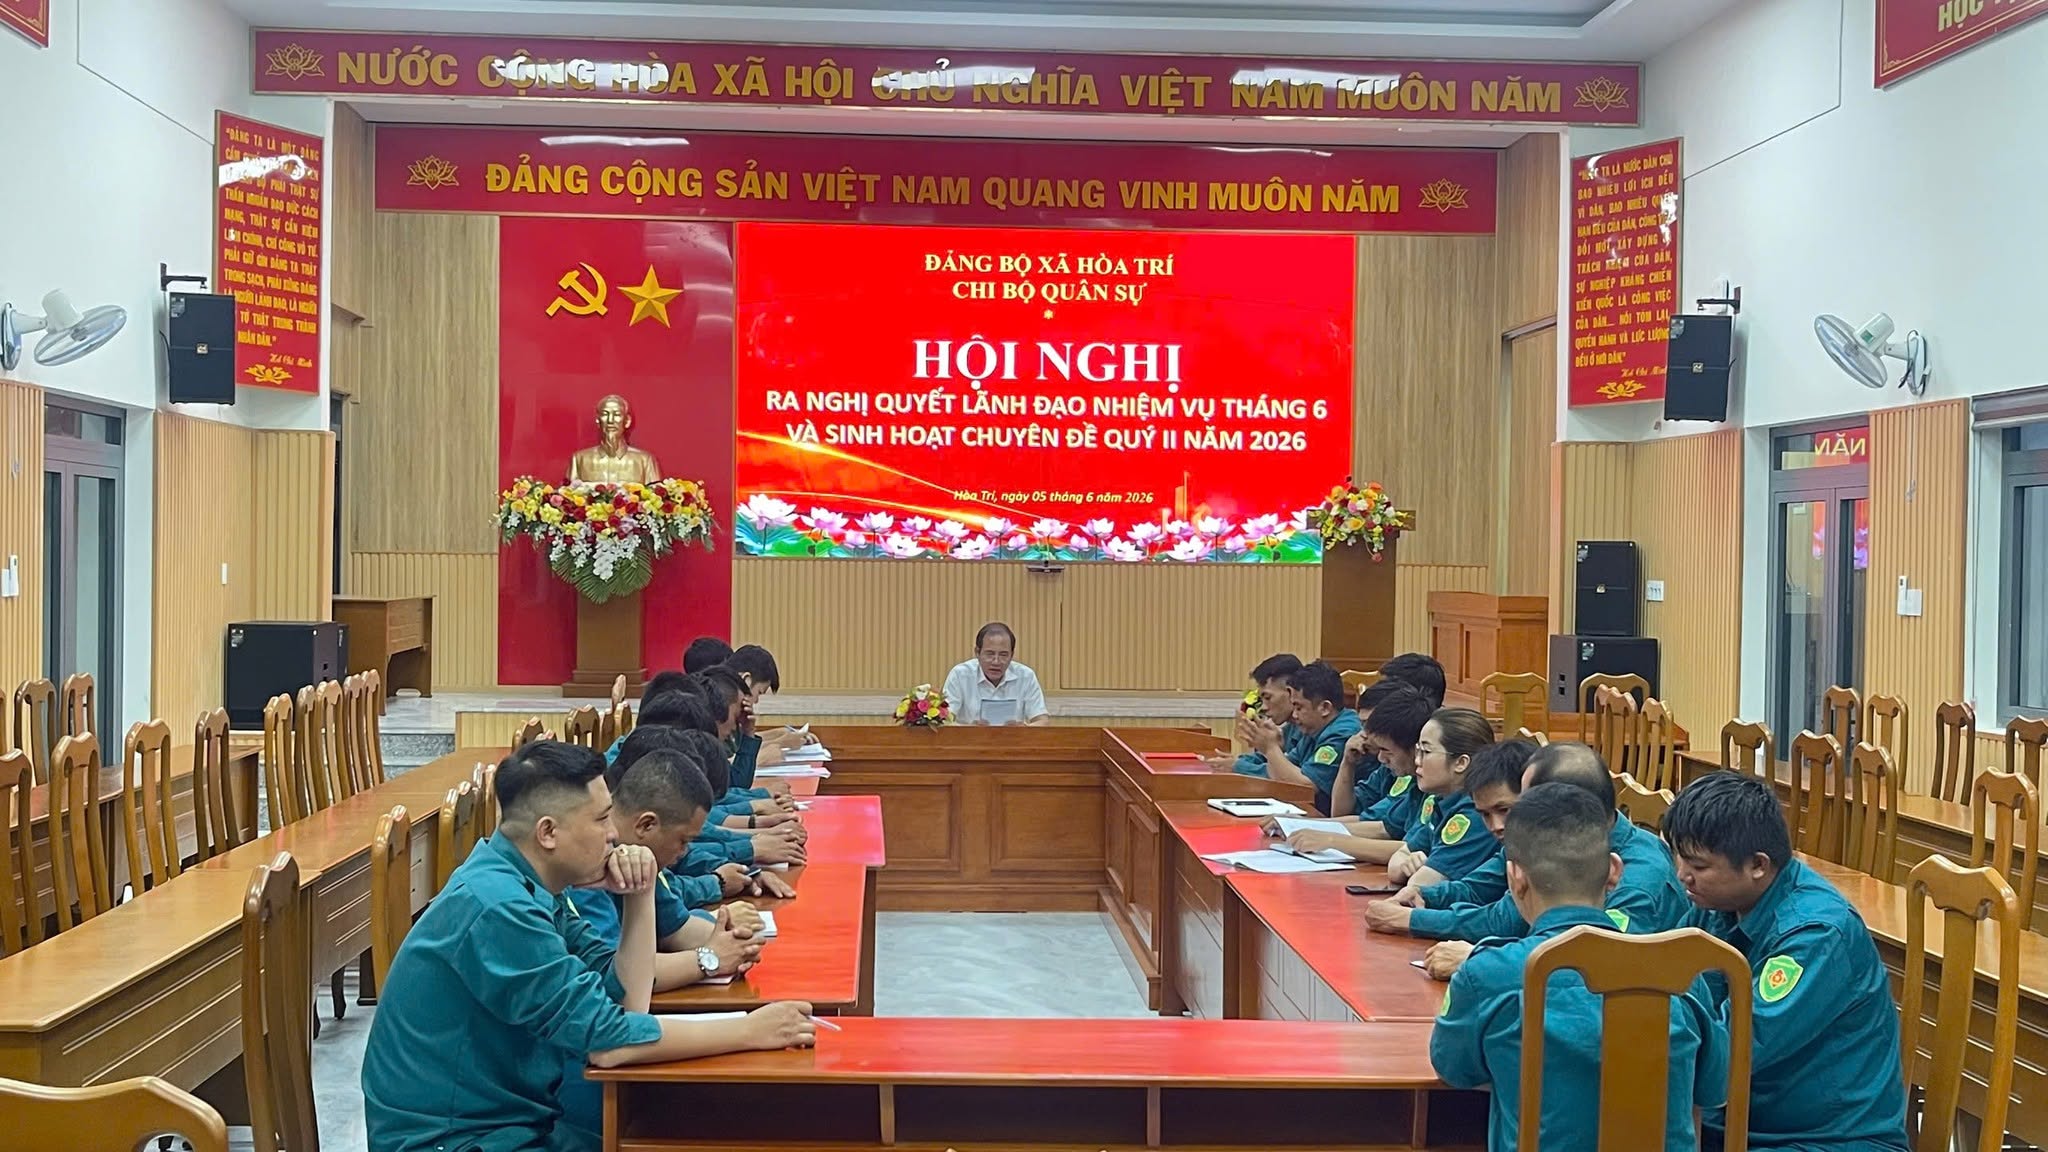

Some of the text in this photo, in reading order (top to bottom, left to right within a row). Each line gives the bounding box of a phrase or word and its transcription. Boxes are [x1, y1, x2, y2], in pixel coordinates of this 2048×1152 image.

[338, 45, 458, 87] NƯỚC
[477, 48, 596, 96] CỘNG
[612, 51, 697, 94] HÒA
[712, 55, 770, 97] XÃ
[785, 58, 853, 105] HỘI
[972, 64, 1099, 106] NGHĨA
[1120, 67, 1213, 114] VIỆT
[1230, 77, 1324, 110] NAM
[1336, 71, 1456, 112] MUÔN
[1471, 75, 1561, 113] NĂM
[485, 153, 1400, 213] ĐẢNG CỘNG SẢN VIỆT NAM QUANG VINH MUÔN NĂM
[924, 250, 1175, 278] ĐẢNG BỘ XÃ HÒA TRÍ
[952, 279, 1148, 306] CHI BỘ QUÂN SỰ
[912, 334, 1182, 394] HỘI NGHỊ
[766, 386, 1328, 422] RA NGHỊ QUYẾT LÃNH ĐẠO NHIỆM VỤ THÁNG 6
[786, 418, 1307, 451] VÀ SINH HOẠT CHUYÊN ĐỀ QUÝ II NĂM 2026
[953, 489, 1154, 505] Hòa Trí, ngày 05 tháng 6 năm 2026
